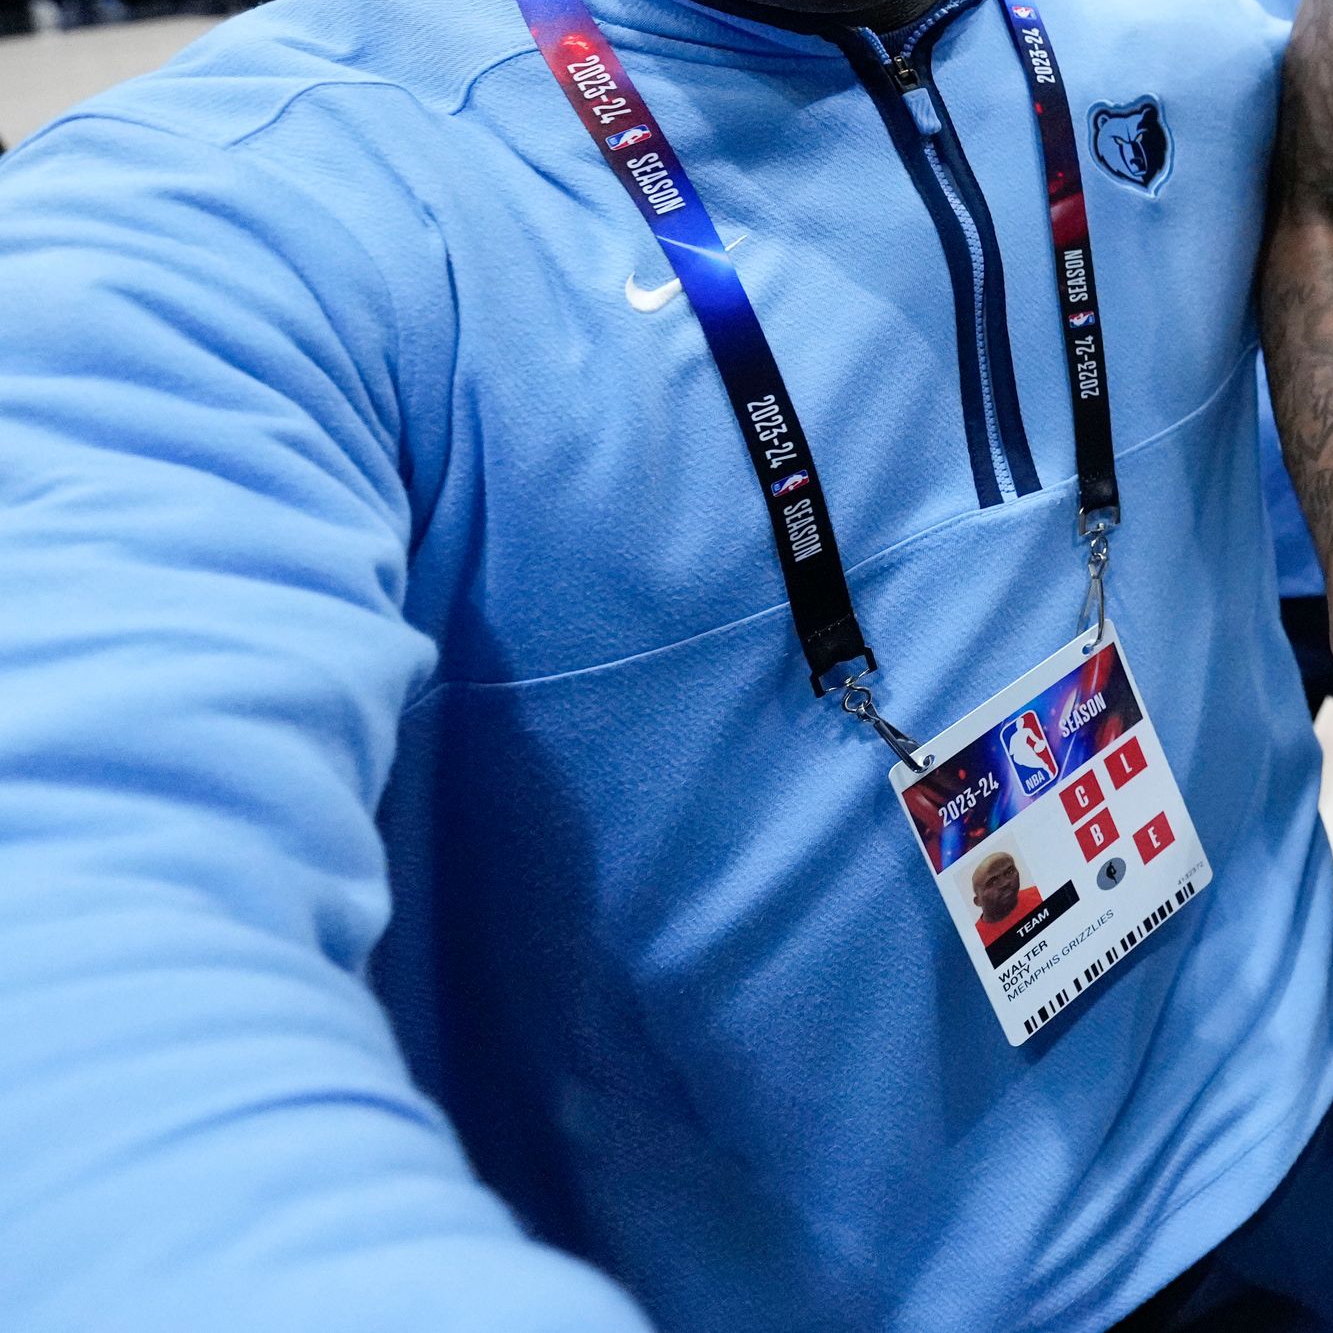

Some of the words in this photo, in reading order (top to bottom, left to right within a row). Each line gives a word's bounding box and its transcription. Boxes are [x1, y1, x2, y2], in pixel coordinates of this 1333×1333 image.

[1022, 27, 1055, 84] 2023-24
[567, 55, 633, 124] 2023-24
[626, 152, 686, 215] SEASON
[1064, 249, 1088, 302] SEASON
[1075, 335, 1099, 399] 2023-24
[747, 394, 797, 469] 2023-24
[783, 498, 822, 562] SEASON
[938, 771, 999, 828] 2023-24
[1060, 692, 1107, 738] SEASON
[1025, 770, 1046, 791] NBA
[1119, 753, 1133, 774] L
[1074, 785, 1090, 808] C
[1090, 823, 1105, 847] B
[1147, 825, 1161, 849] E
[1016, 908, 1050, 938] TEAM
[998, 939, 1049, 983] WALTER
[1007, 953, 1061, 1003] MEMPHIS
[1061, 909, 1115, 957] GRIZZLIES
[1002, 964, 1032, 993] DOTY
